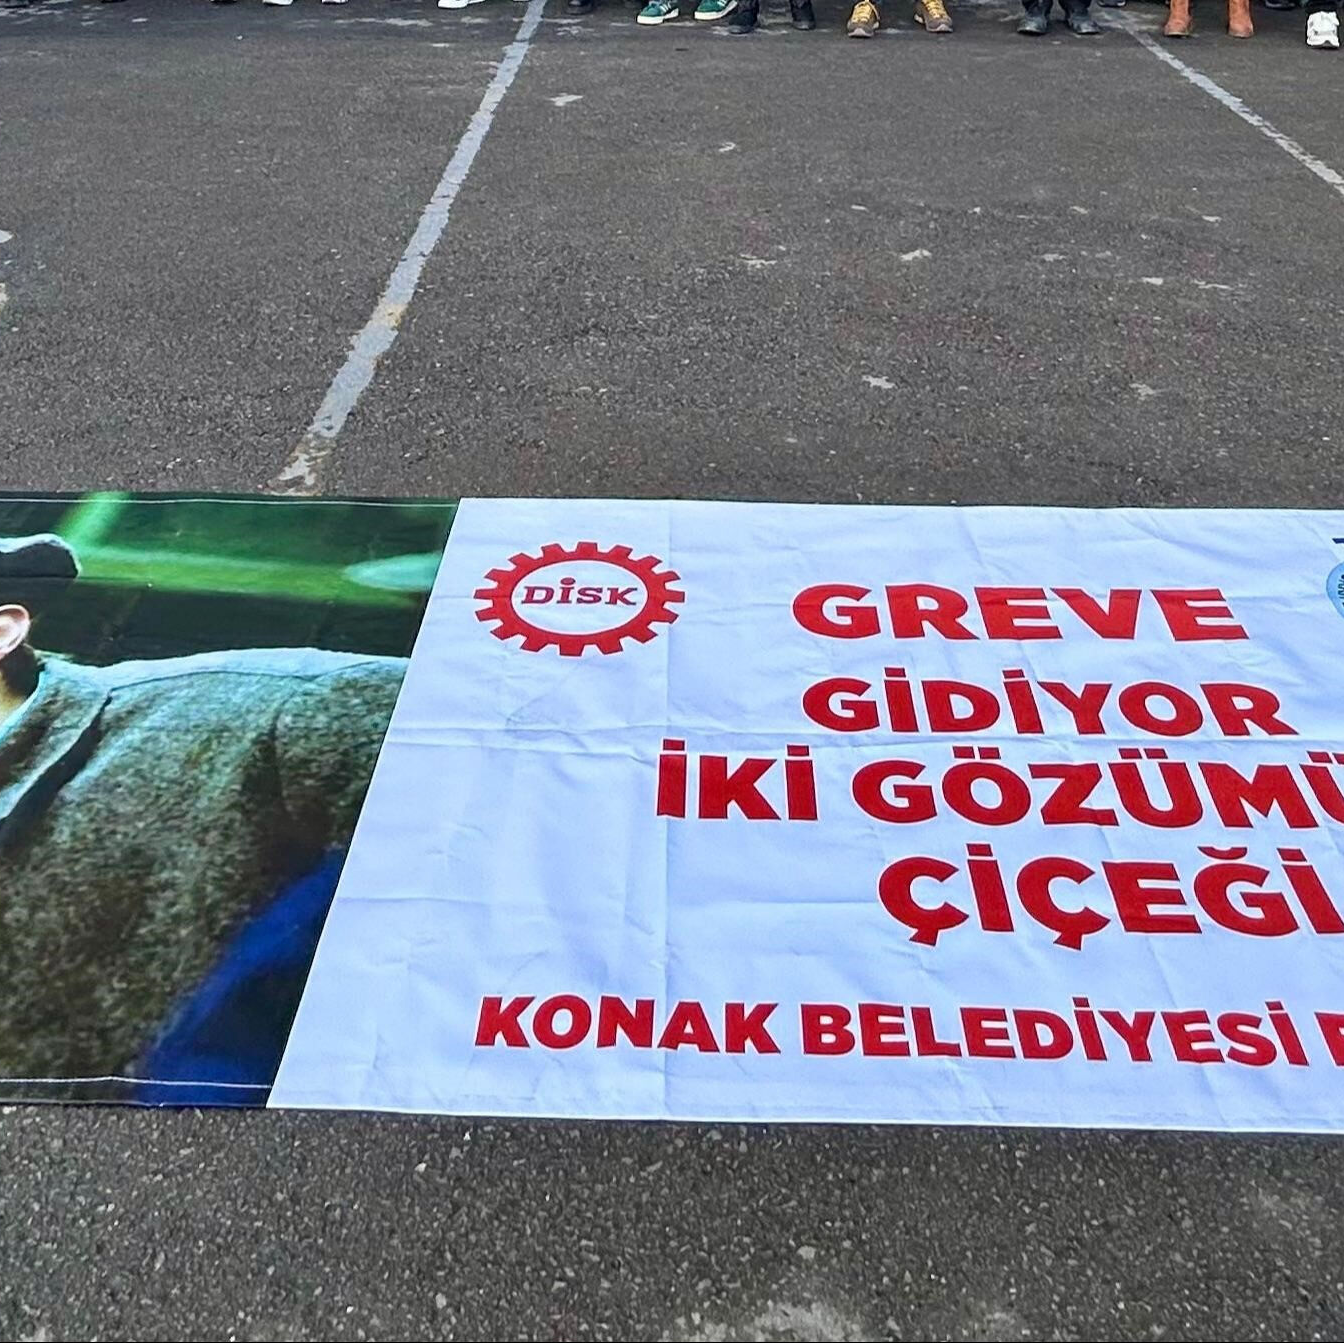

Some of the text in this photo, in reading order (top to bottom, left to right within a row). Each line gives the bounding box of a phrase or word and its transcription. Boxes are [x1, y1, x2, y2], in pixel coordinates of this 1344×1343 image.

[520, 576, 639, 606] DİSK
[791, 583, 1251, 643] GREVE
[801, 666, 1301, 737] GİDİYOR
[656, 738, 819, 822] İKİ
[473, 994, 781, 1055] KONAK
[800, 996, 1310, 1067] BELEDİYESİ
